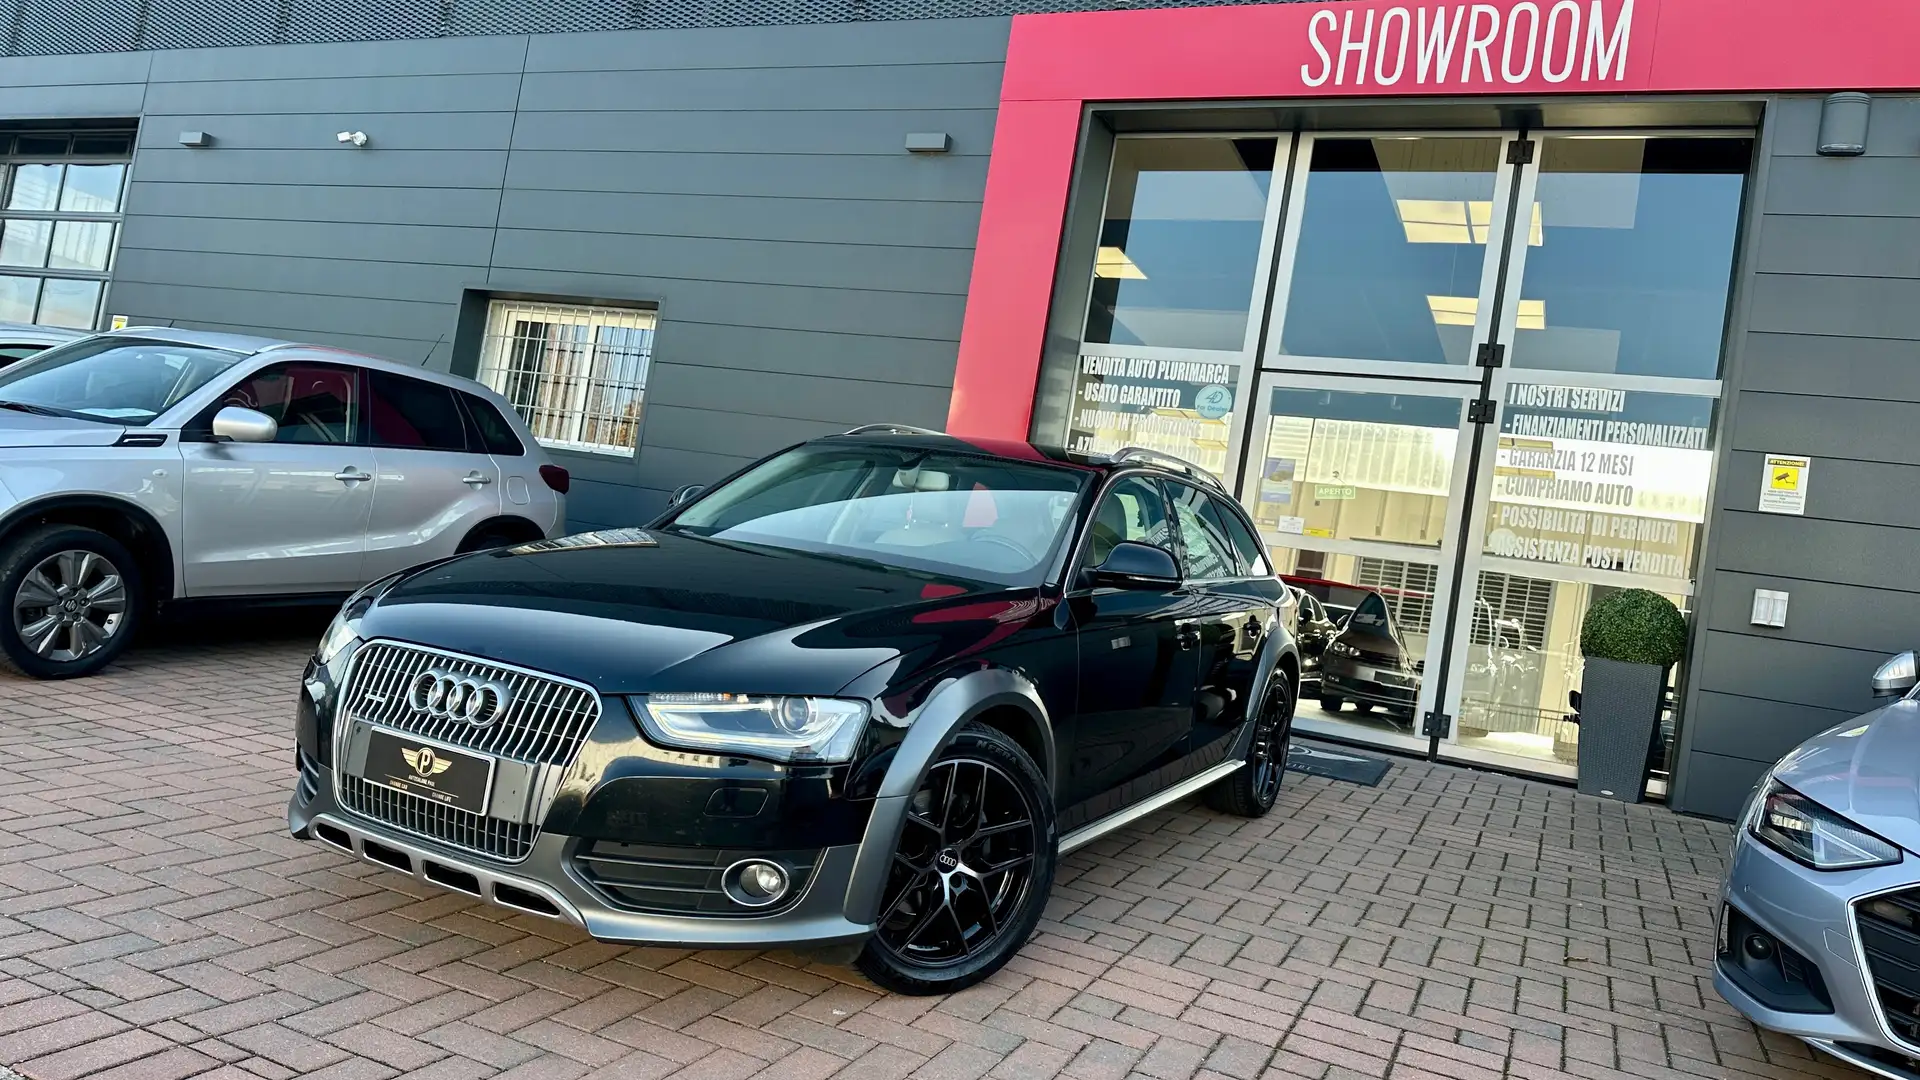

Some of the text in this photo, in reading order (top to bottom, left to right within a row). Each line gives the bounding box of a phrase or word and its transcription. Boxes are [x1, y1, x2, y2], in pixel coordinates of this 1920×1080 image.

[1301, 0, 1635, 87] SHOWROOM
[1082, 355, 1230, 384] VENDITA AUTO PLURIMARCA
[1083, 382, 1181, 408] USATO GARANTITO
[1509, 383, 1626, 412] I NOSTRI SERVIZI
[1079, 409, 1116, 430] NUOVO
[1117, 412, 1130, 431] IN
[1511, 414, 1708, 449] FINANZIAMENTI PERSONALIZZATI
[1509, 448, 1635, 476] GARANZIA 12 MESI
[1318, 487, 1352, 495] APERTO
[1505, 475, 1633, 507] COMPRIAMO AUTO
[1500, 506, 1678, 544] POSSIBILITA' DI PERMUTA
[1494, 534, 1683, 578] ASSISTENZA POST VENDITA
